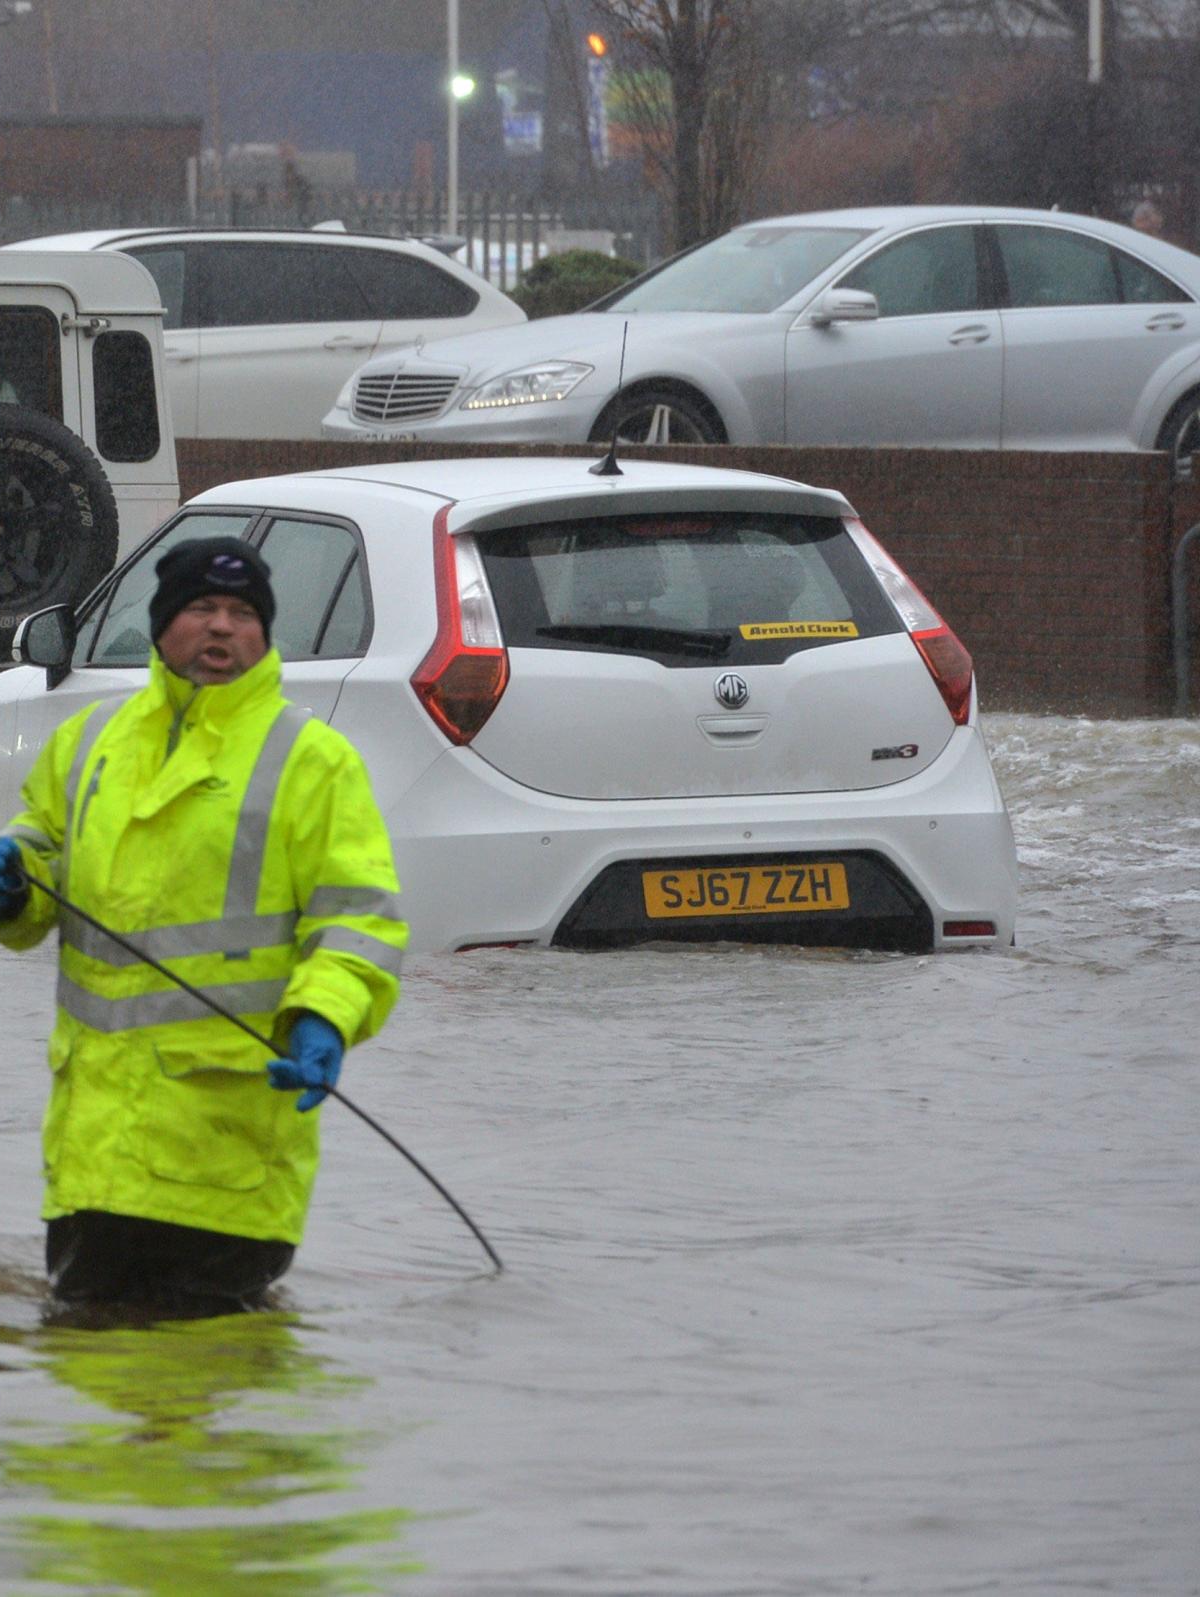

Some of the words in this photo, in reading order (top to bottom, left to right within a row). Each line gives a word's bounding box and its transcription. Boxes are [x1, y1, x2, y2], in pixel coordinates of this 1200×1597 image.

[68, 482, 94, 527] ATR
[749, 625, 805, 635] Arnold
[808, 624, 849, 634] Clark
[718, 675, 747, 705] MG
[660, 872, 750, 908] SJ67
[762, 868, 833, 904] ZZH
